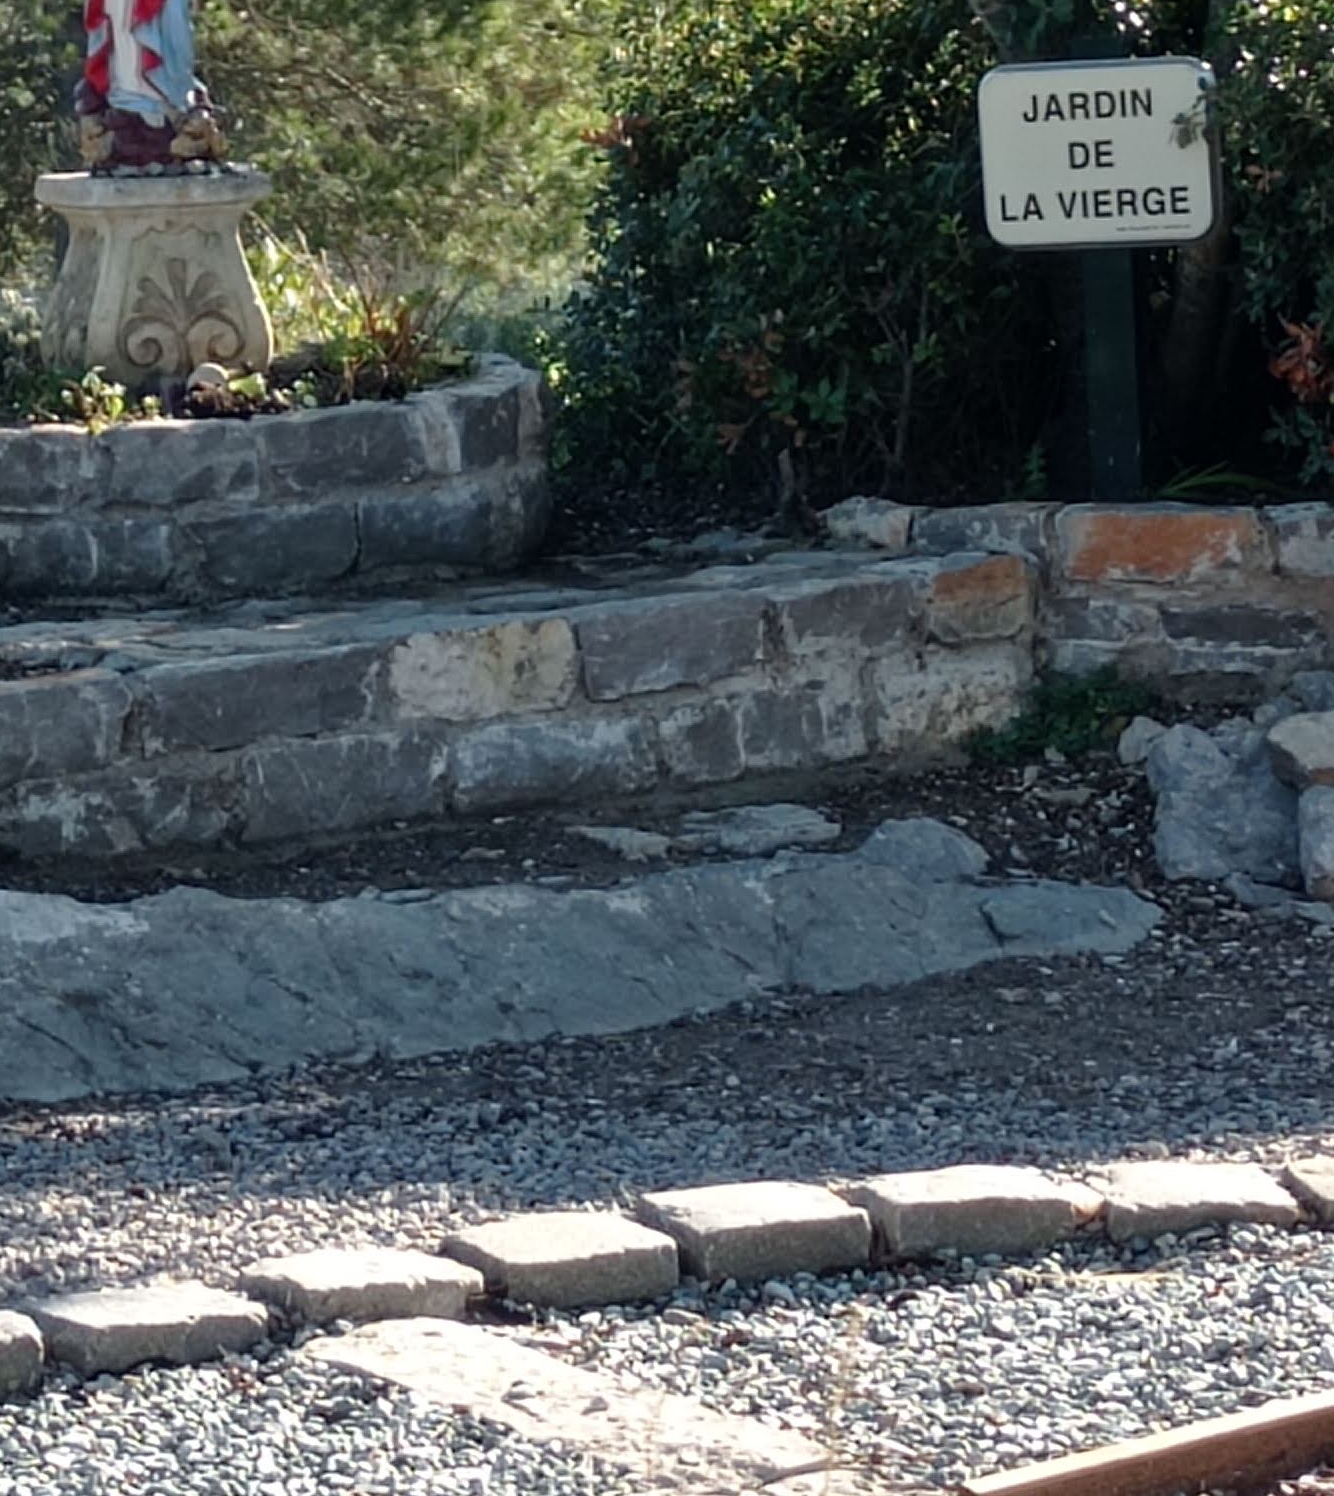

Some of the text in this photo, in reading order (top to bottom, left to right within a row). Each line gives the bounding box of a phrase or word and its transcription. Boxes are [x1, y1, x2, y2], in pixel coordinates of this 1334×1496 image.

[1023, 87, 1153, 123] JARDIN
[1068, 139, 1115, 169] DE
[1000, 186, 1191, 222] LA VIERGE
